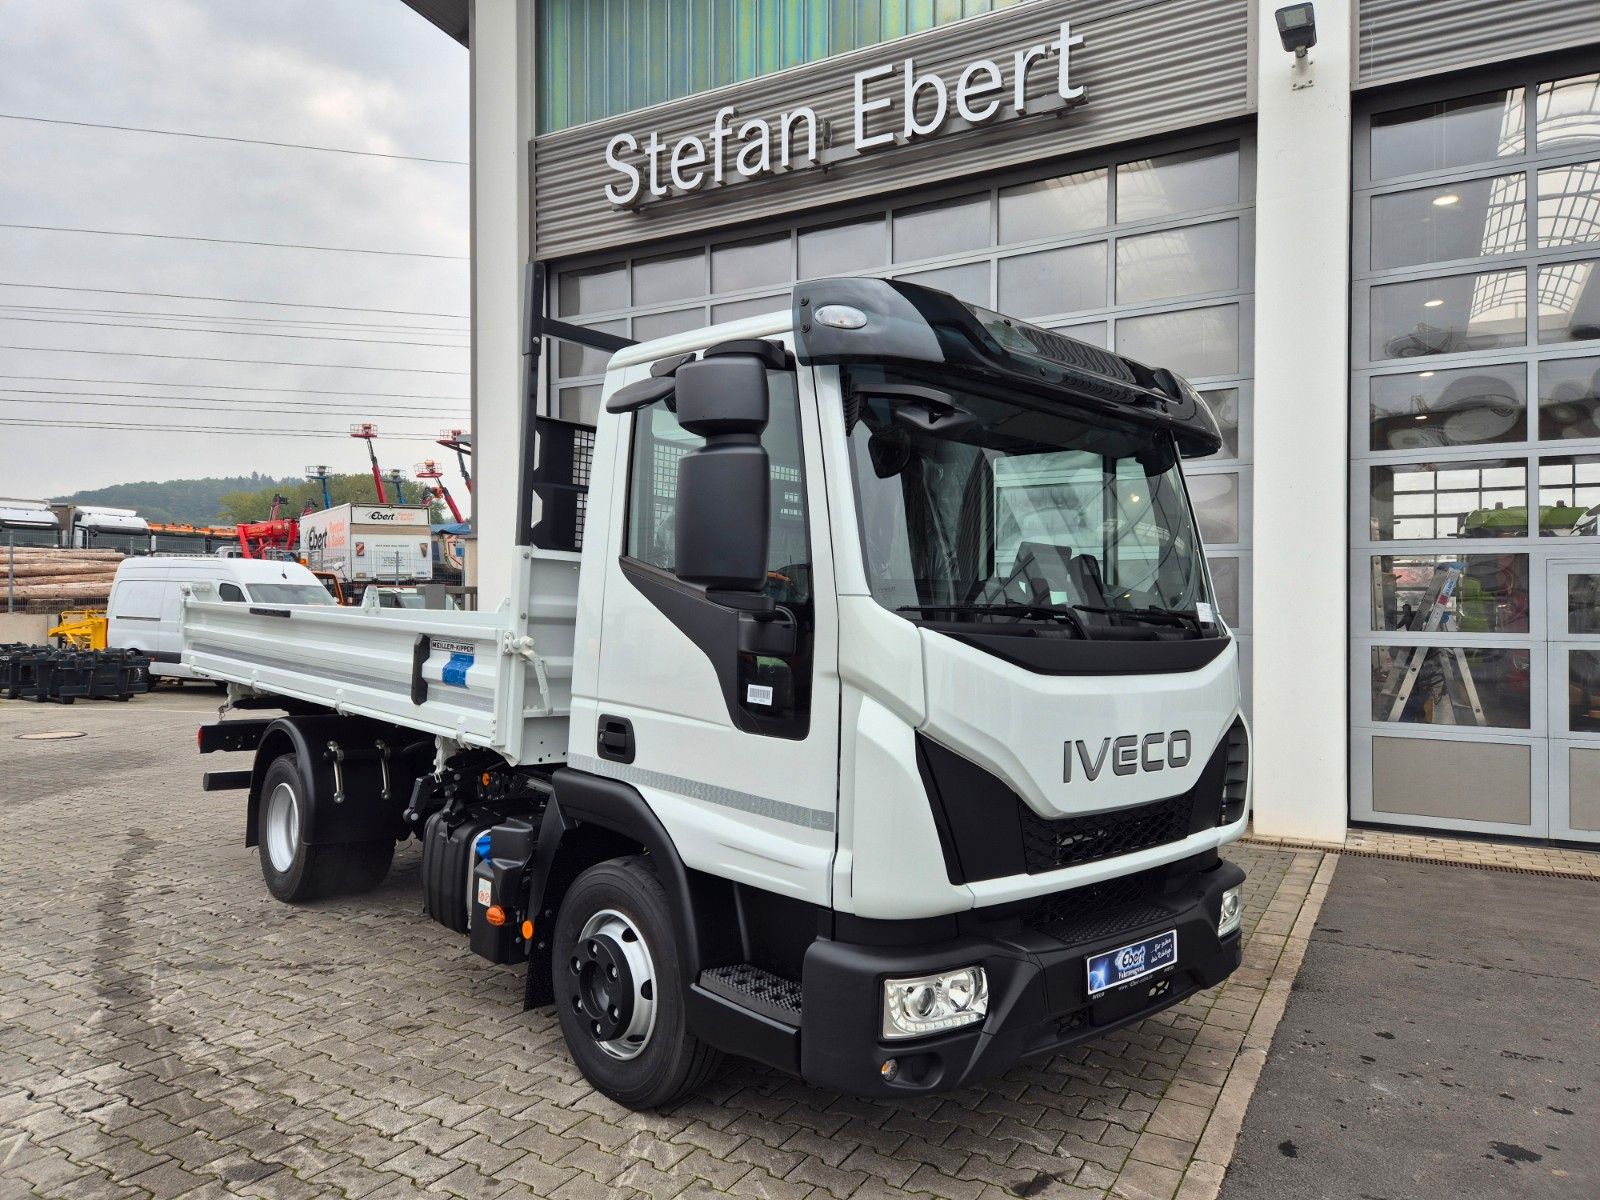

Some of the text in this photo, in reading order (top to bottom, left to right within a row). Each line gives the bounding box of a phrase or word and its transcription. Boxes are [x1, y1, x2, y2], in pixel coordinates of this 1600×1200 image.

[604, 21, 1086, 206] Stefan Ebert
[371, 511, 396, 521] Ebert
[309, 526, 328, 551] Ebert
[432, 641, 474, 653] MEILLER-KIPPER
[1063, 729, 1192, 784] IVECO
[1122, 950, 1145, 968] Ebert
